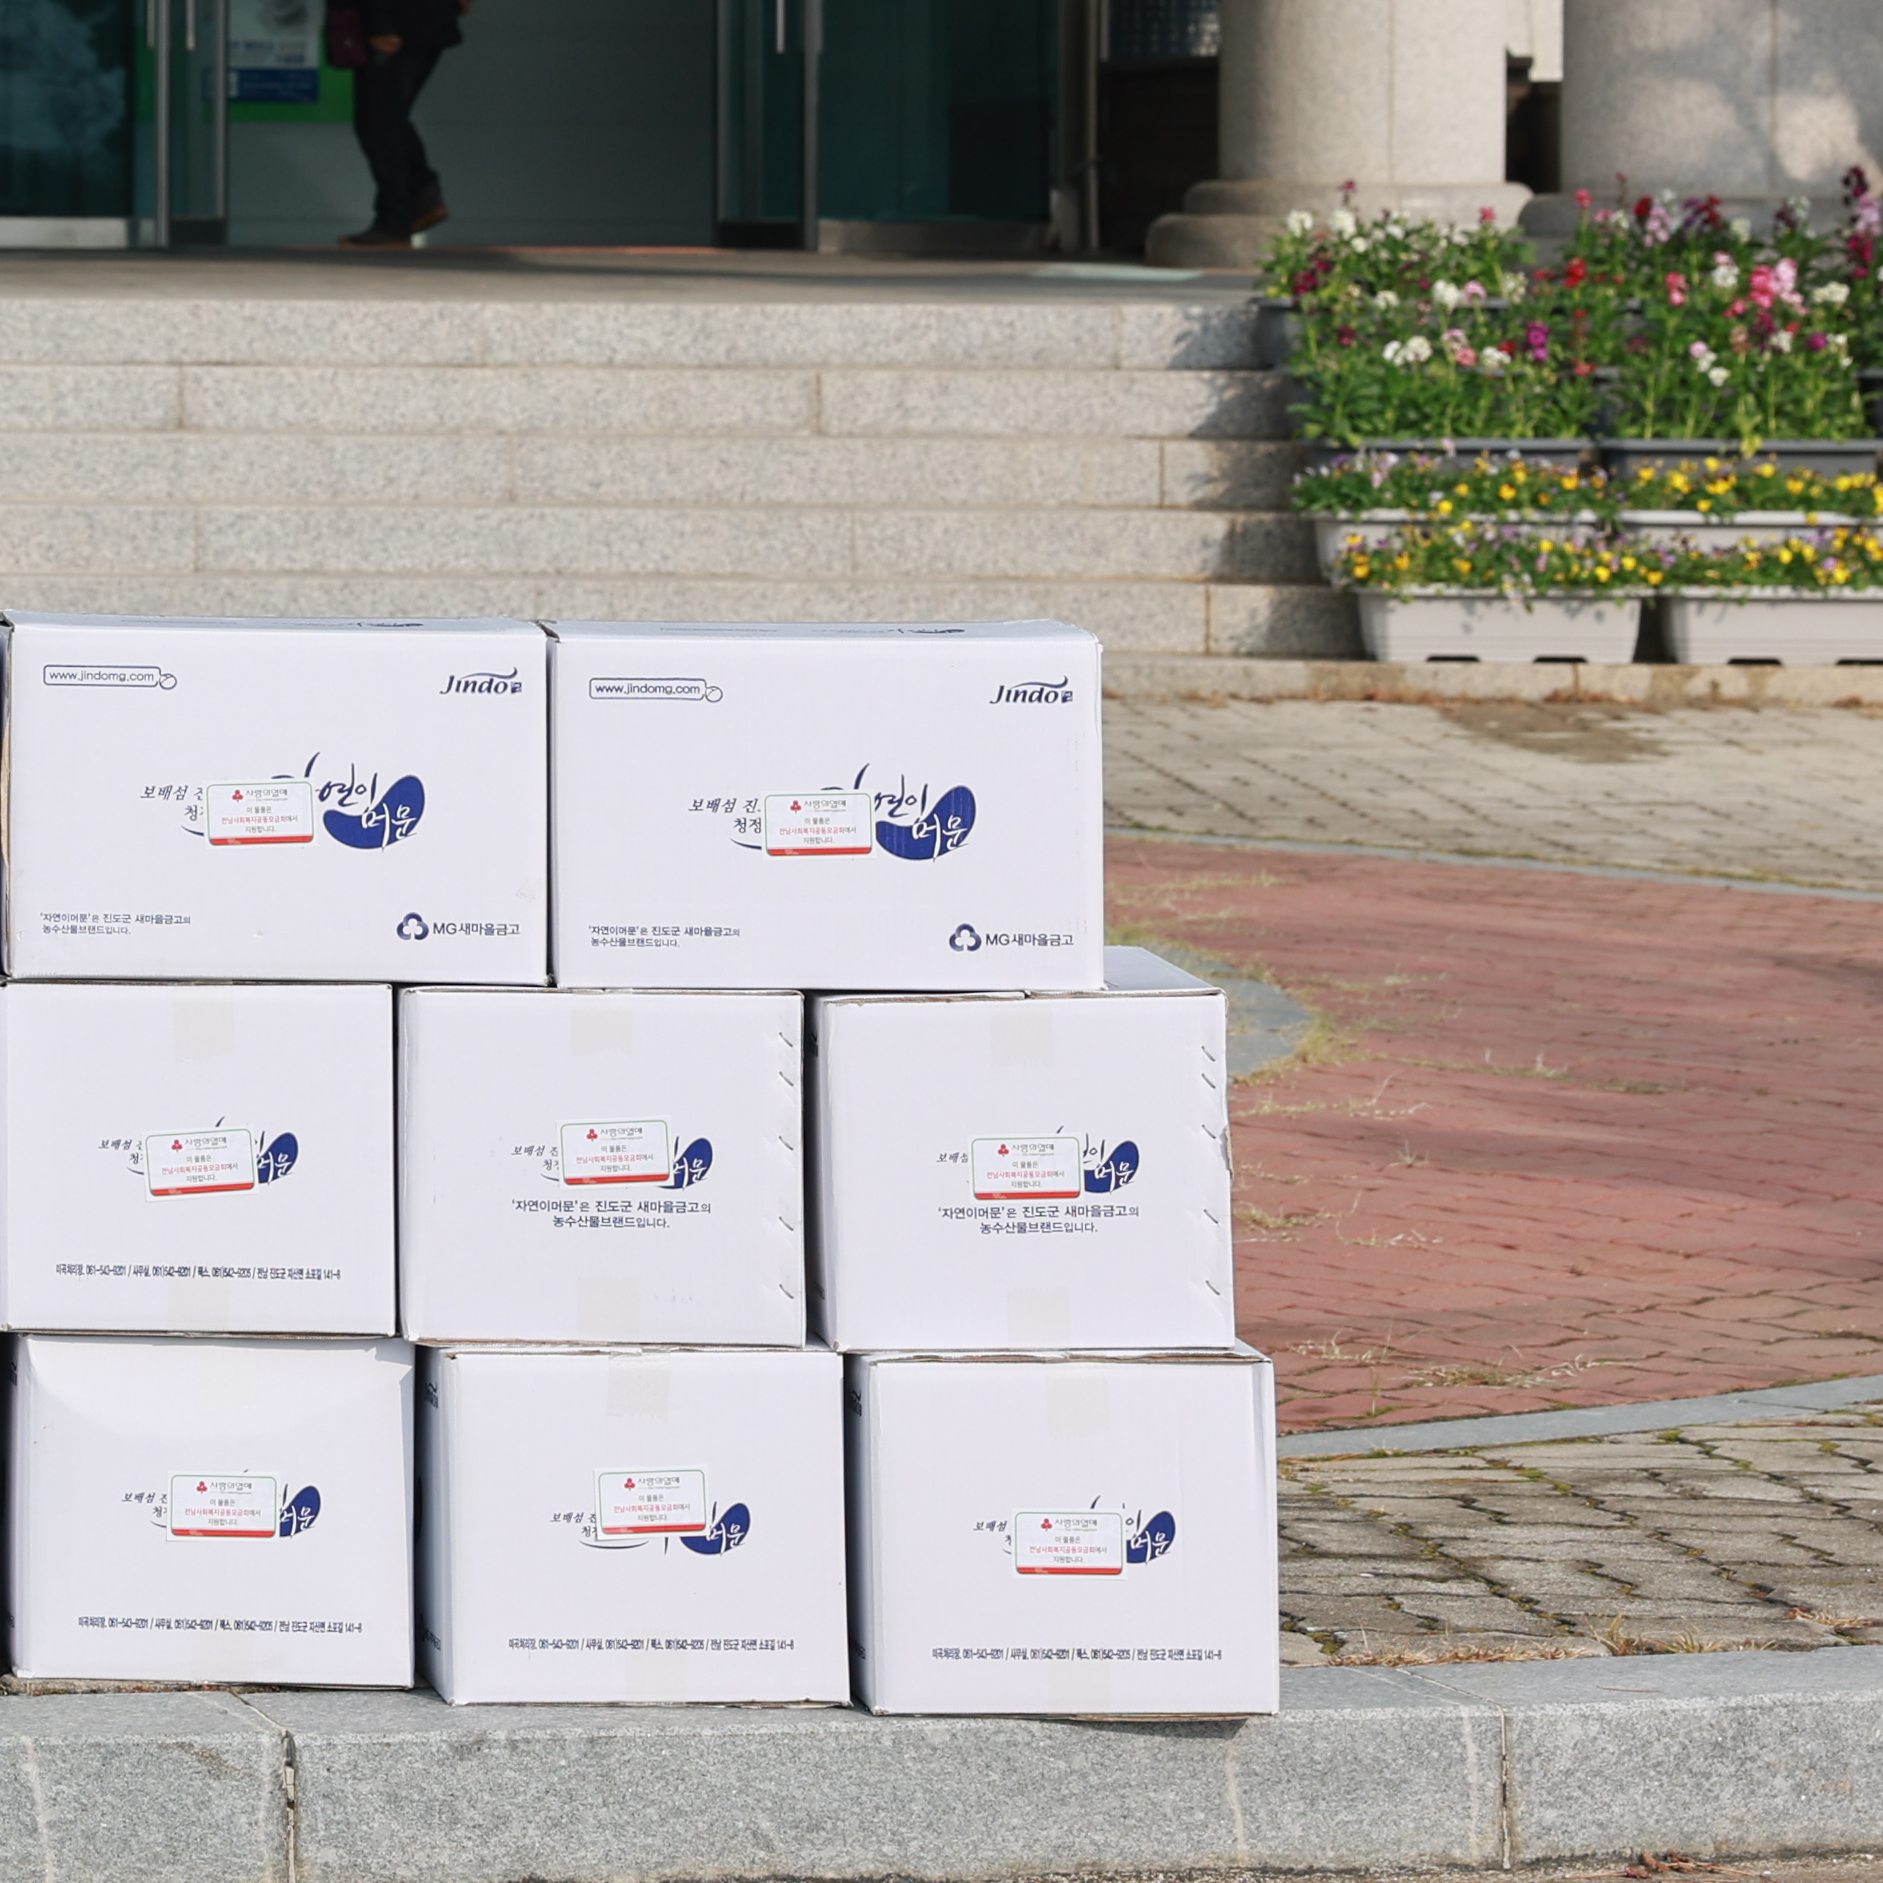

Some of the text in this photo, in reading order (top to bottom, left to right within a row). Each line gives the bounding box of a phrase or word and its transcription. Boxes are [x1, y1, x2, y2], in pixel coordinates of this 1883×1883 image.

[49, 671, 155, 683] www.jindomg.com
[439, 672, 512, 695] Jindo
[595, 682, 701, 696] www.jindomg.com
[989, 685, 1059, 705] Jindo
[140, 784, 189, 801] 보배섬
[688, 797, 738, 814] 보배섬
[102, 913, 132, 924] 진도군
[134, 914, 191, 925] 새마을금고의
[42, 924, 129, 935] 농수산물브랜드입니다.
[651, 926, 681, 937] 진도군
[683, 926, 740, 937] 새마을금고의
[590, 937, 678, 948] 농수산물브랜드입니다.
[594, 1200, 633, 1213] 진도군
[636, 1200, 711, 1214] 새마을금고의
[1022, 1205, 1060, 1219] 진도군
[1064, 1204, 1139, 1218] 새마을금고의
[552, 1215, 667, 1229] 농수산물브랜드입니다.
[979, 1221, 1098, 1235] 농수산물브랜드입니다.
